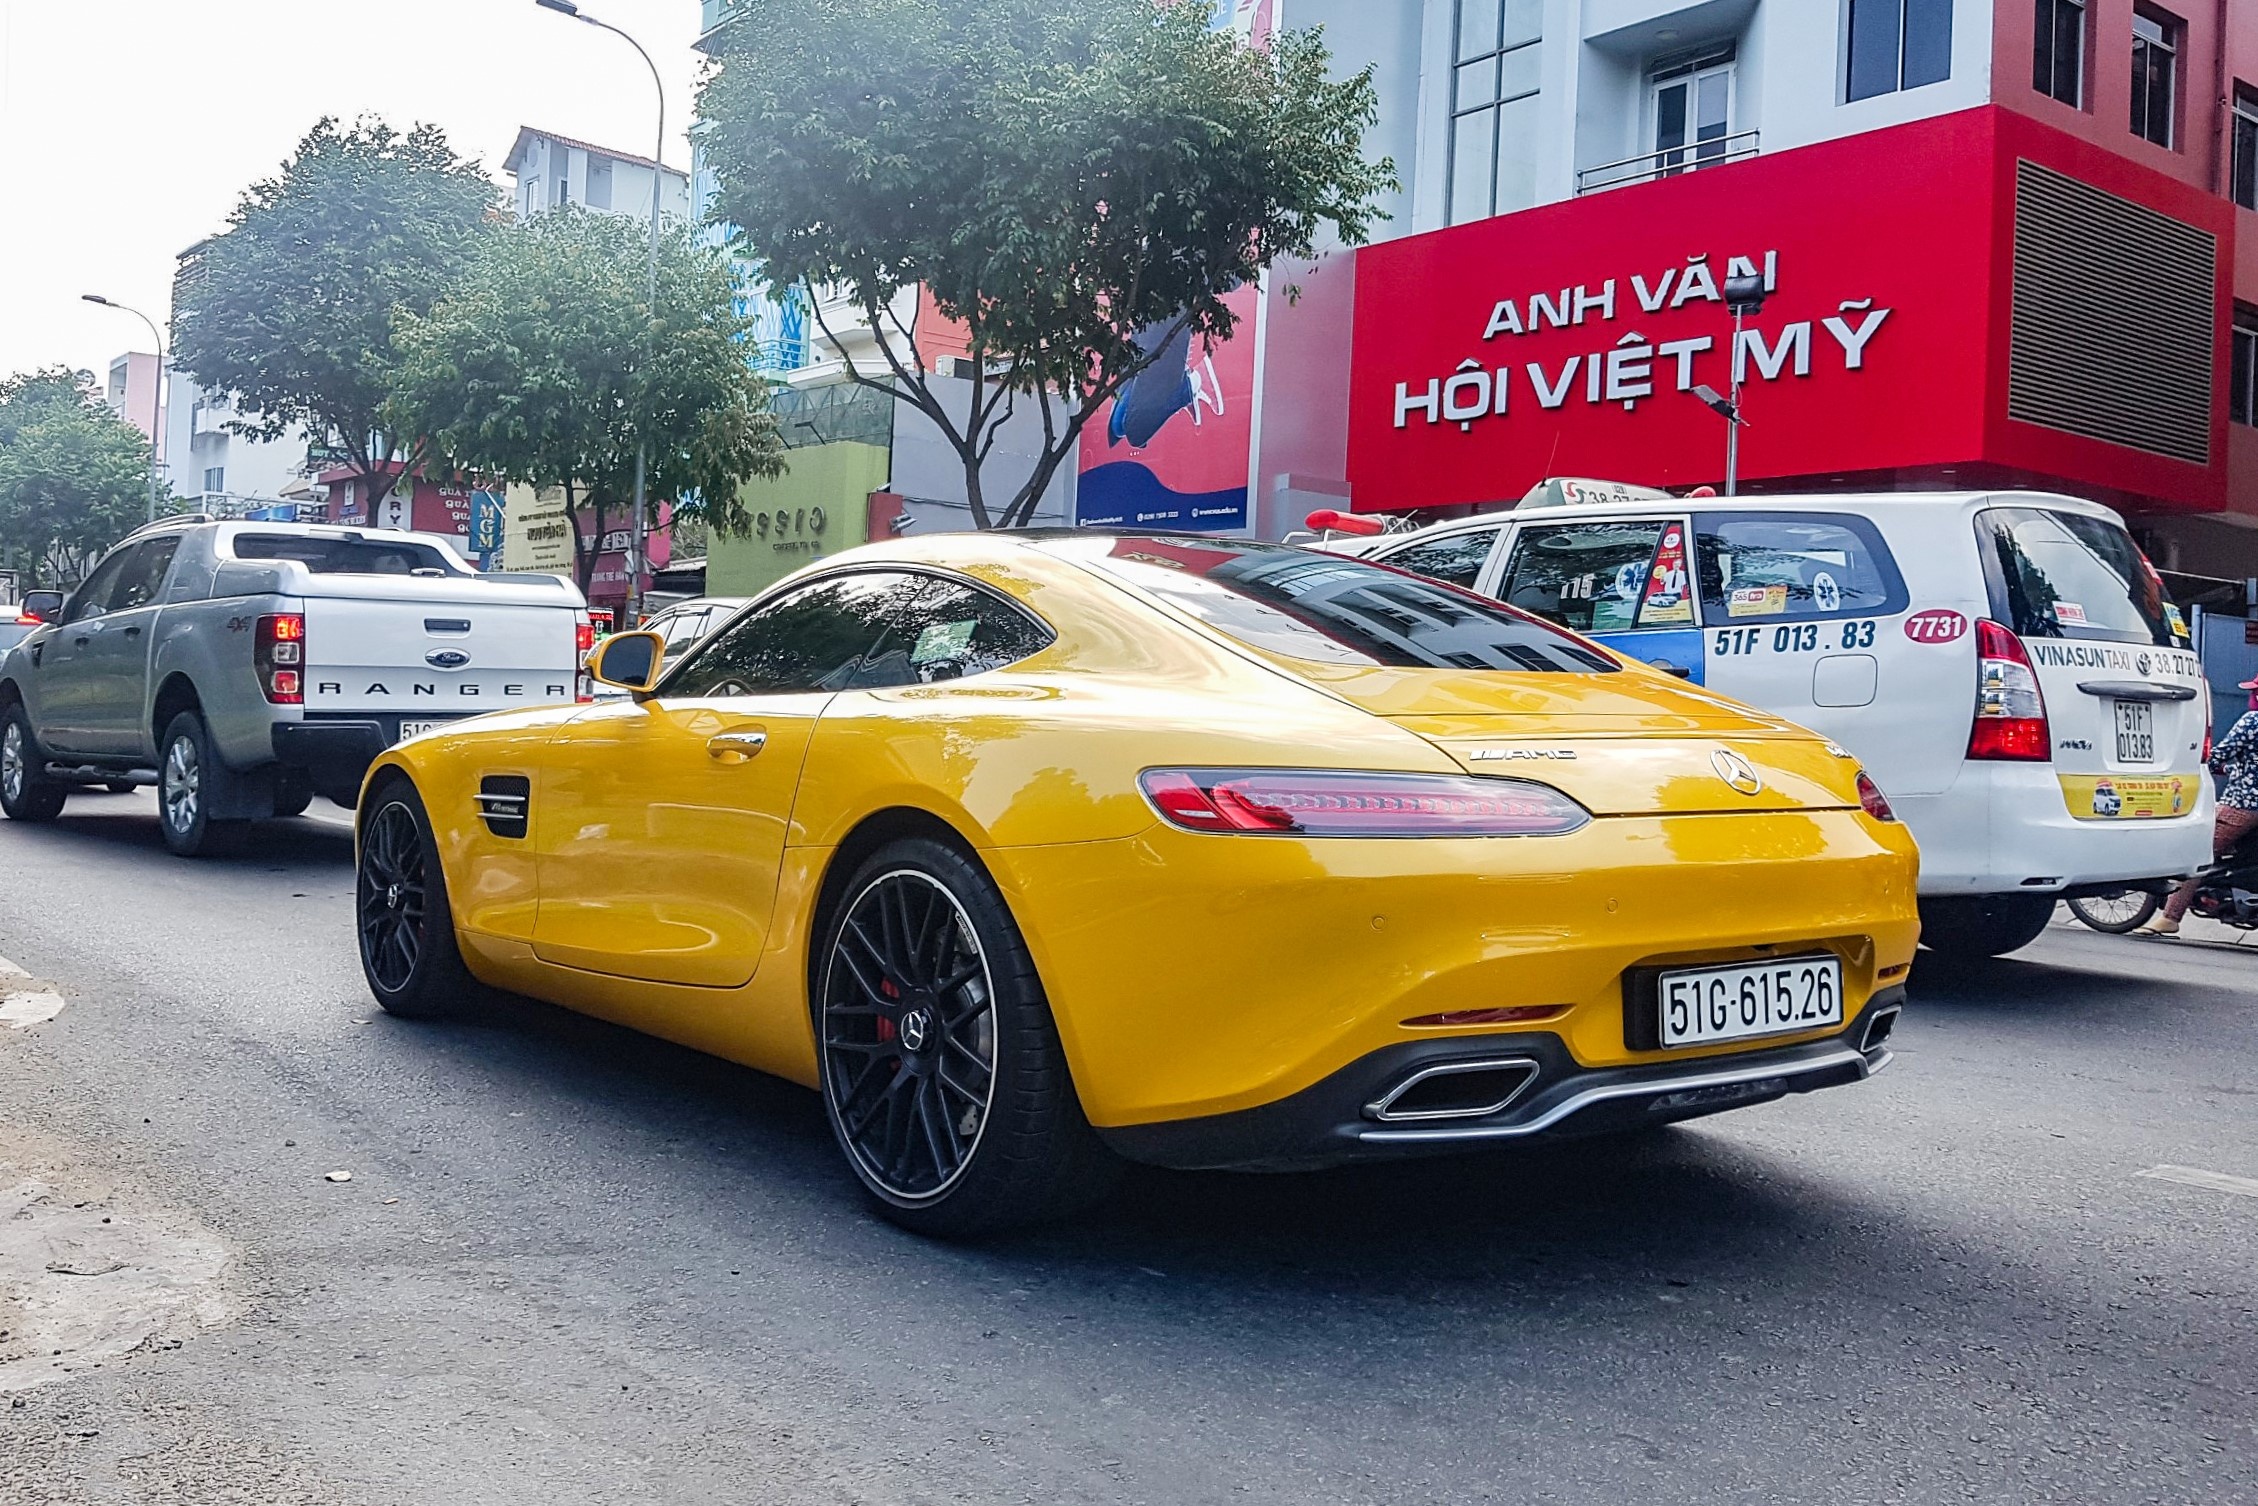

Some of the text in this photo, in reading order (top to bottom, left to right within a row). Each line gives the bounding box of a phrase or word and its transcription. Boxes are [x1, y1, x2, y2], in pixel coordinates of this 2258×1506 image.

[1483, 249, 1778, 341] ANH VĂN
[1393, 297, 1892, 432] HỘI VIỆT MỸ
[479, 503, 496, 548] MGM
[1910, 616, 1962, 638] 7731
[1714, 628, 1761, 656] 51F
[318, 682, 566, 696] RANGER
[2124, 704, 2143, 732] 51F
[1505, 748, 1577, 760] AMG
[1669, 966, 1834, 1037] 51G-615.26
